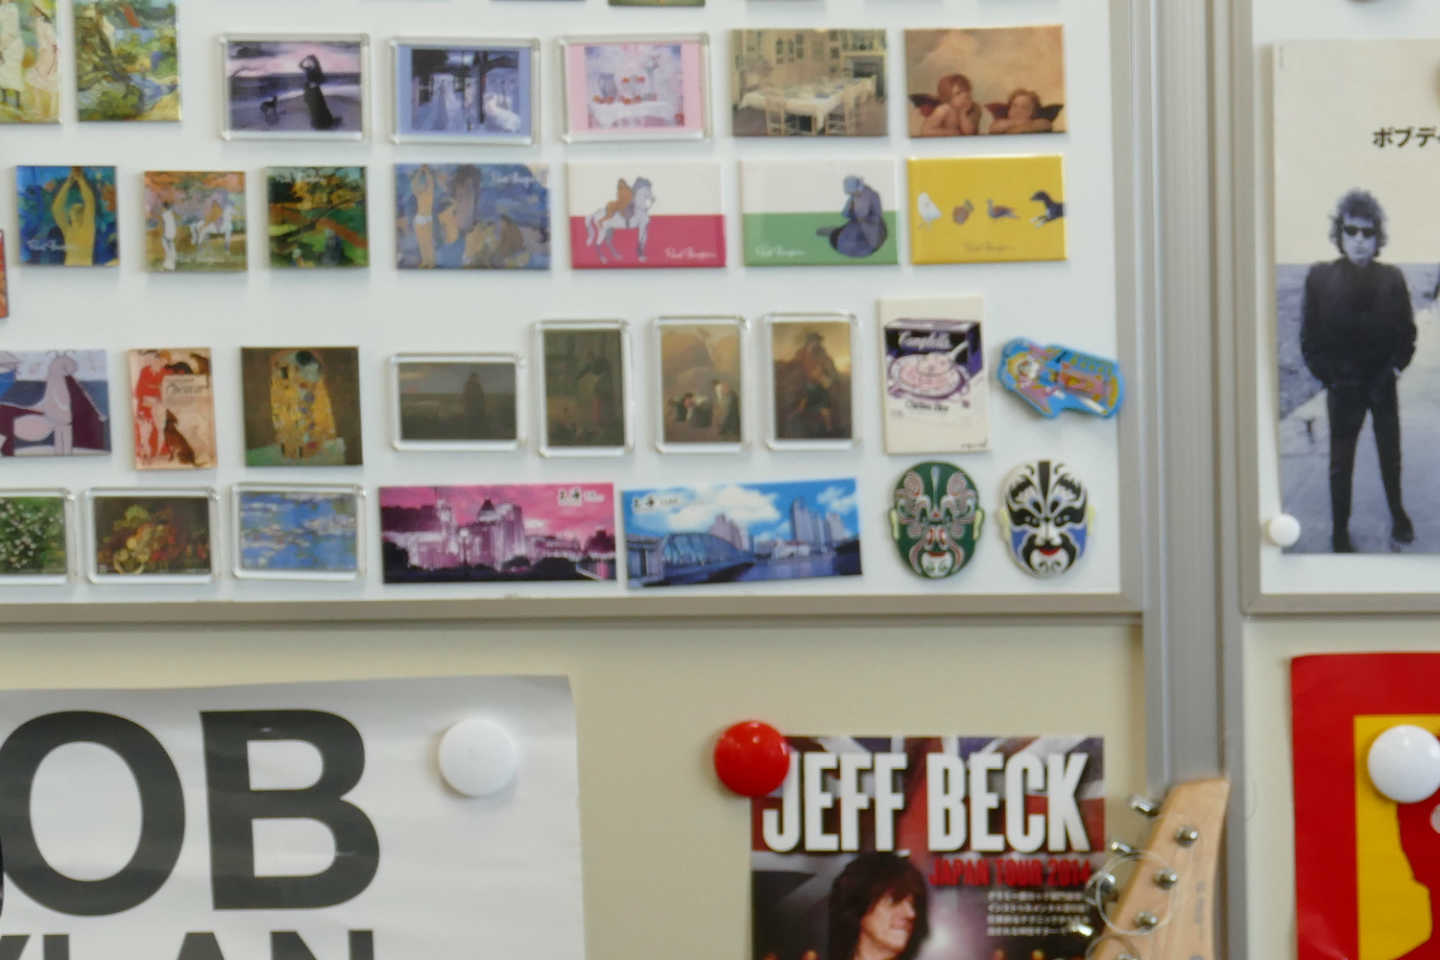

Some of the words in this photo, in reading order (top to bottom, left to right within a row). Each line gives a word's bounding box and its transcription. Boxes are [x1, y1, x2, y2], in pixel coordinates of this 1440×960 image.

[762, 752, 908, 853] JEFF
[926, 752, 1090, 852] BECK
[929, 859, 990, 886] JAPAN
[996, 859, 1043, 886] TOUR
[1049, 858, 1092, 886] 2014
